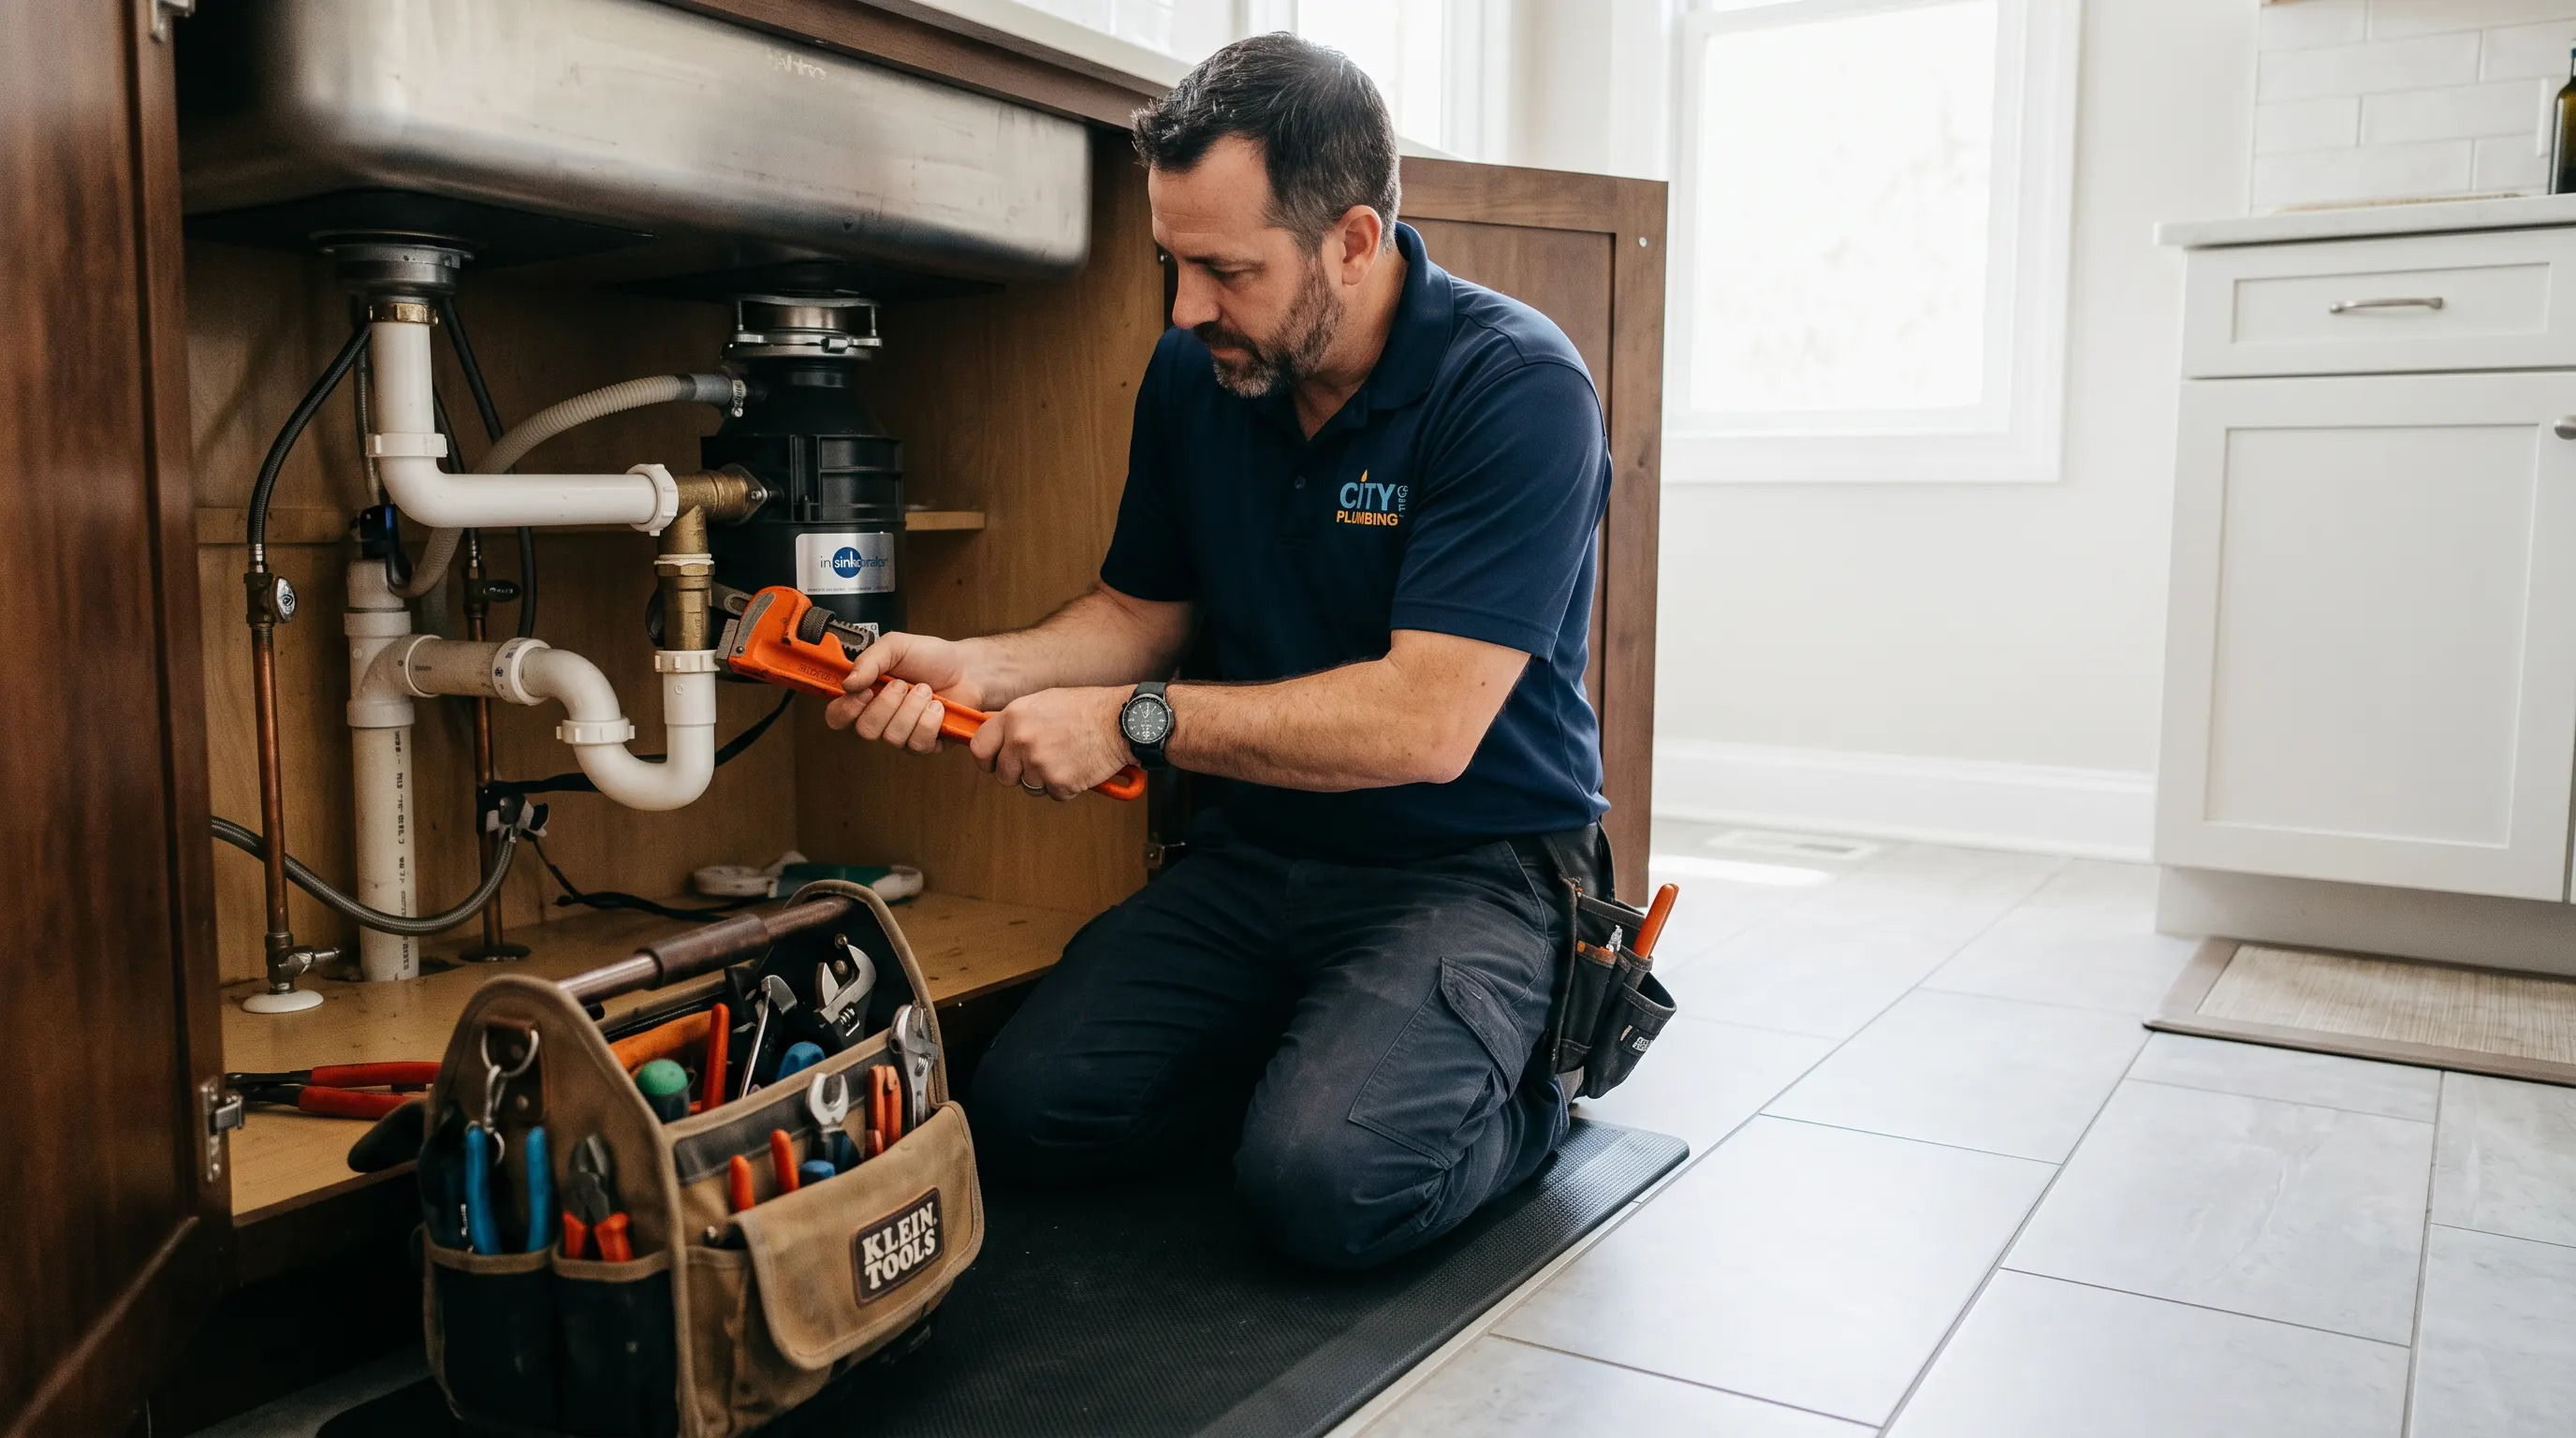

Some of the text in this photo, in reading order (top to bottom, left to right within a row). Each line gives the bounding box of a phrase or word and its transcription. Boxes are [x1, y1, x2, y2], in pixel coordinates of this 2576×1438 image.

[1339, 481, 1397, 511] CITY
[1336, 509, 1398, 526] PLUMBING
[864, 1228, 936, 1290] TOOLS
